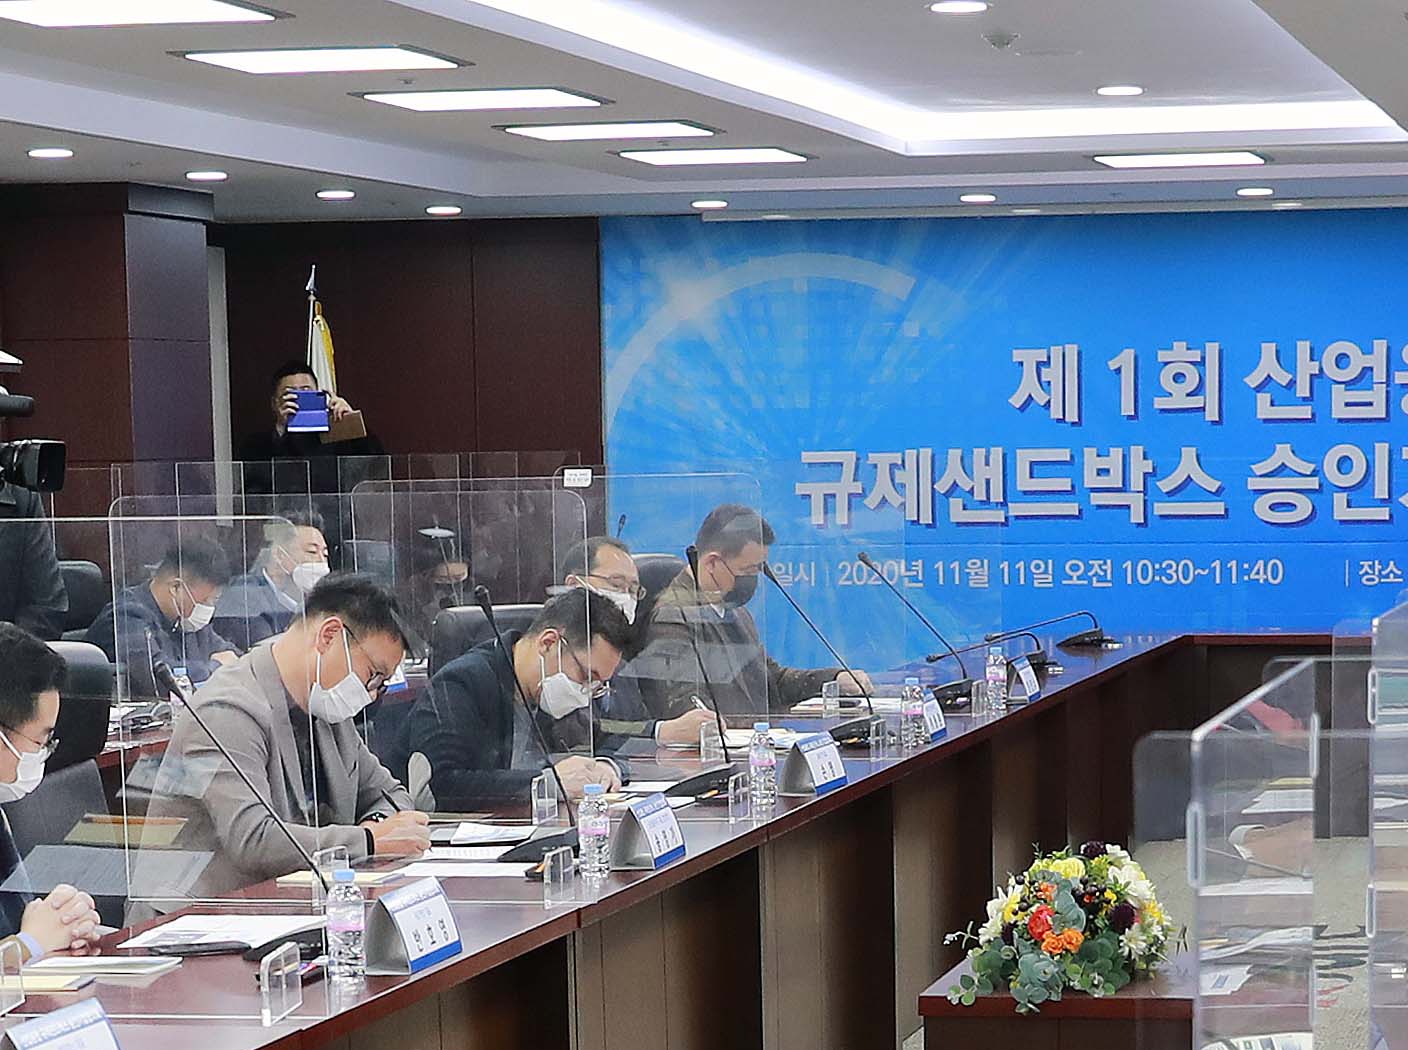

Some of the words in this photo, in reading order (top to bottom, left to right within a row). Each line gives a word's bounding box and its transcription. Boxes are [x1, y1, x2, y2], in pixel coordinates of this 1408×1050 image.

[1008, 343, 1080, 423] 제
[1107, 340, 1221, 422] 1회
[795, 445, 1226, 525] 규제샌드박스
[773, 560, 816, 588] 일시
[838, 559, 925, 588] 2020년
[934, 559, 991, 588] 11월
[999, 559, 1055, 588] 11일
[1062, 559, 1114, 588] 오전
[1122, 559, 1285, 586] 10:30~11:40
[1358, 558, 1404, 587] 장소
